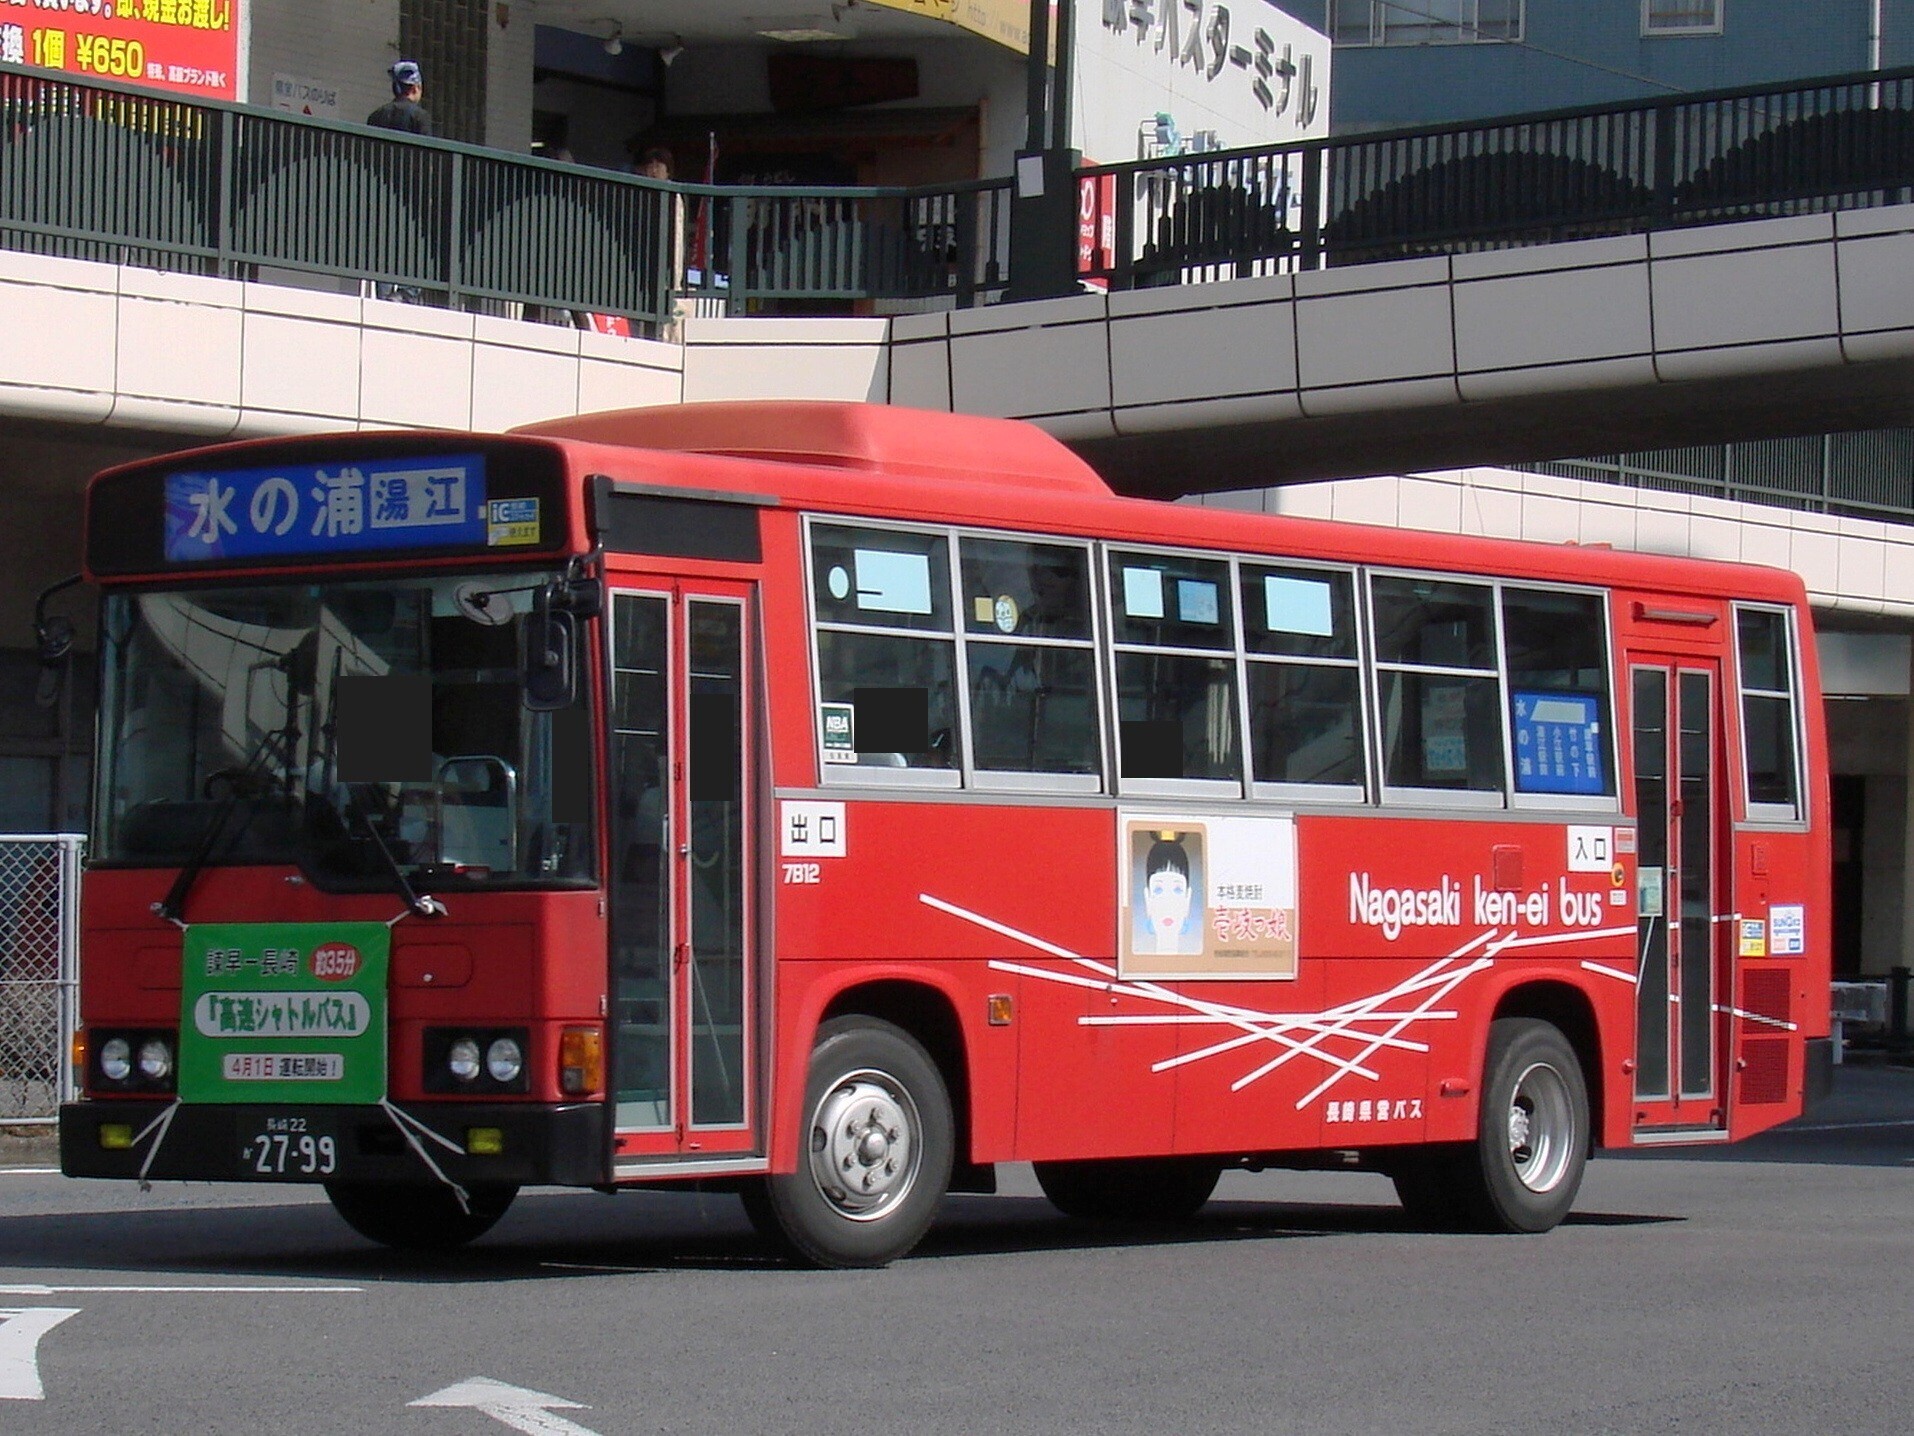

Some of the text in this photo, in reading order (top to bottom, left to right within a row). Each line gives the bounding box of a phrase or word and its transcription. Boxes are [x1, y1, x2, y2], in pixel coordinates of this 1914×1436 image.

[32, 28, 65, 69] 1個
[76, 33, 144, 78] ¥650
[188, 467, 462, 544] 水の浦 湯江
[791, 813, 836, 844] 出口
[1575, 836, 1607, 861] 入口
[782, 863, 821, 884] 7B12
[1349, 872, 1461, 941] Nagasaki
[1474, 873, 1549, 926] ken-ei
[1559, 876, 1603, 926] bus
[289, 1118, 307, 1132] 22
[1326, 1099, 1422, 1123] 長崎県営バス
